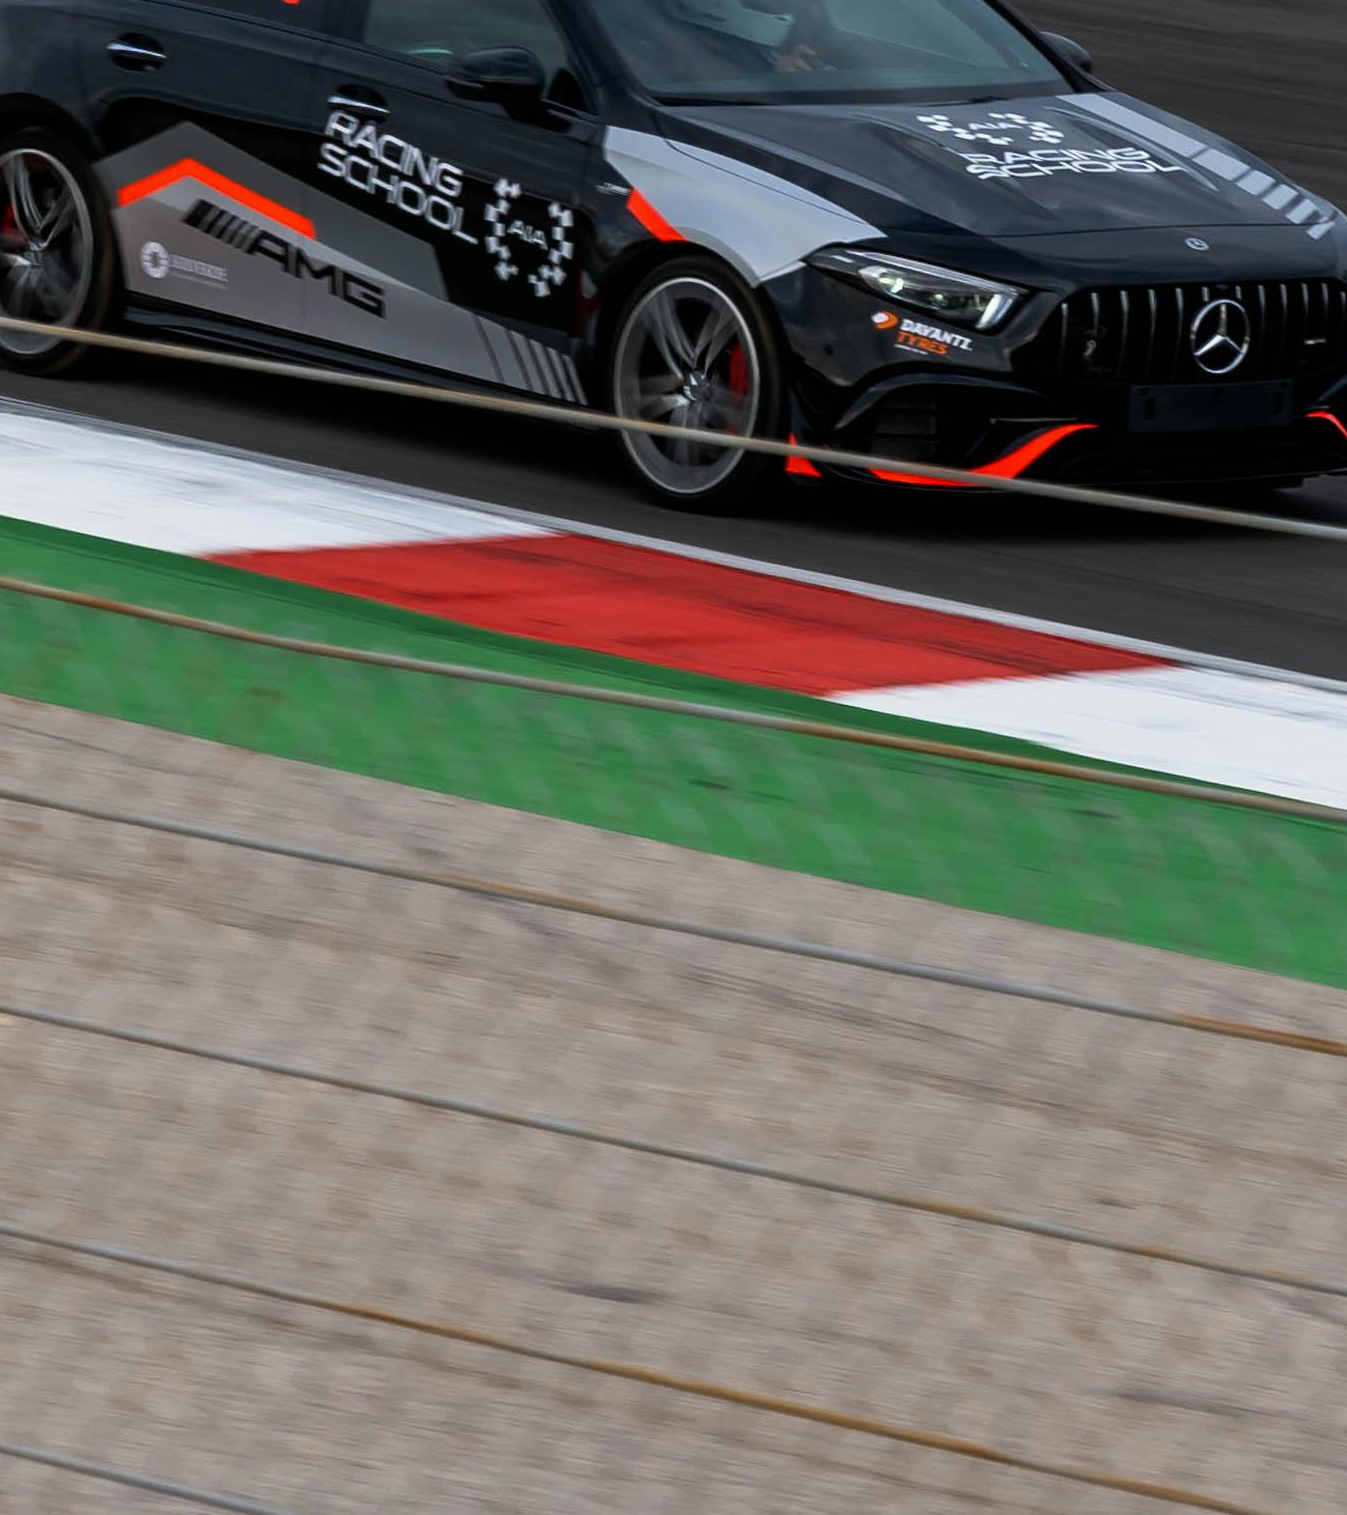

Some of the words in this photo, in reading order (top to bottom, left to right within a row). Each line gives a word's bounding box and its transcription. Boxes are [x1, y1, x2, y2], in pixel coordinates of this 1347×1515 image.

[325, 111, 464, 197] RACING
[960, 147, 1150, 164] RACING
[966, 160, 1186, 179] SCHOOL
[317, 142, 478, 244] SCHOOL
[249, 229, 387, 318] AMG
[899, 318, 973, 351] DAVANTI
